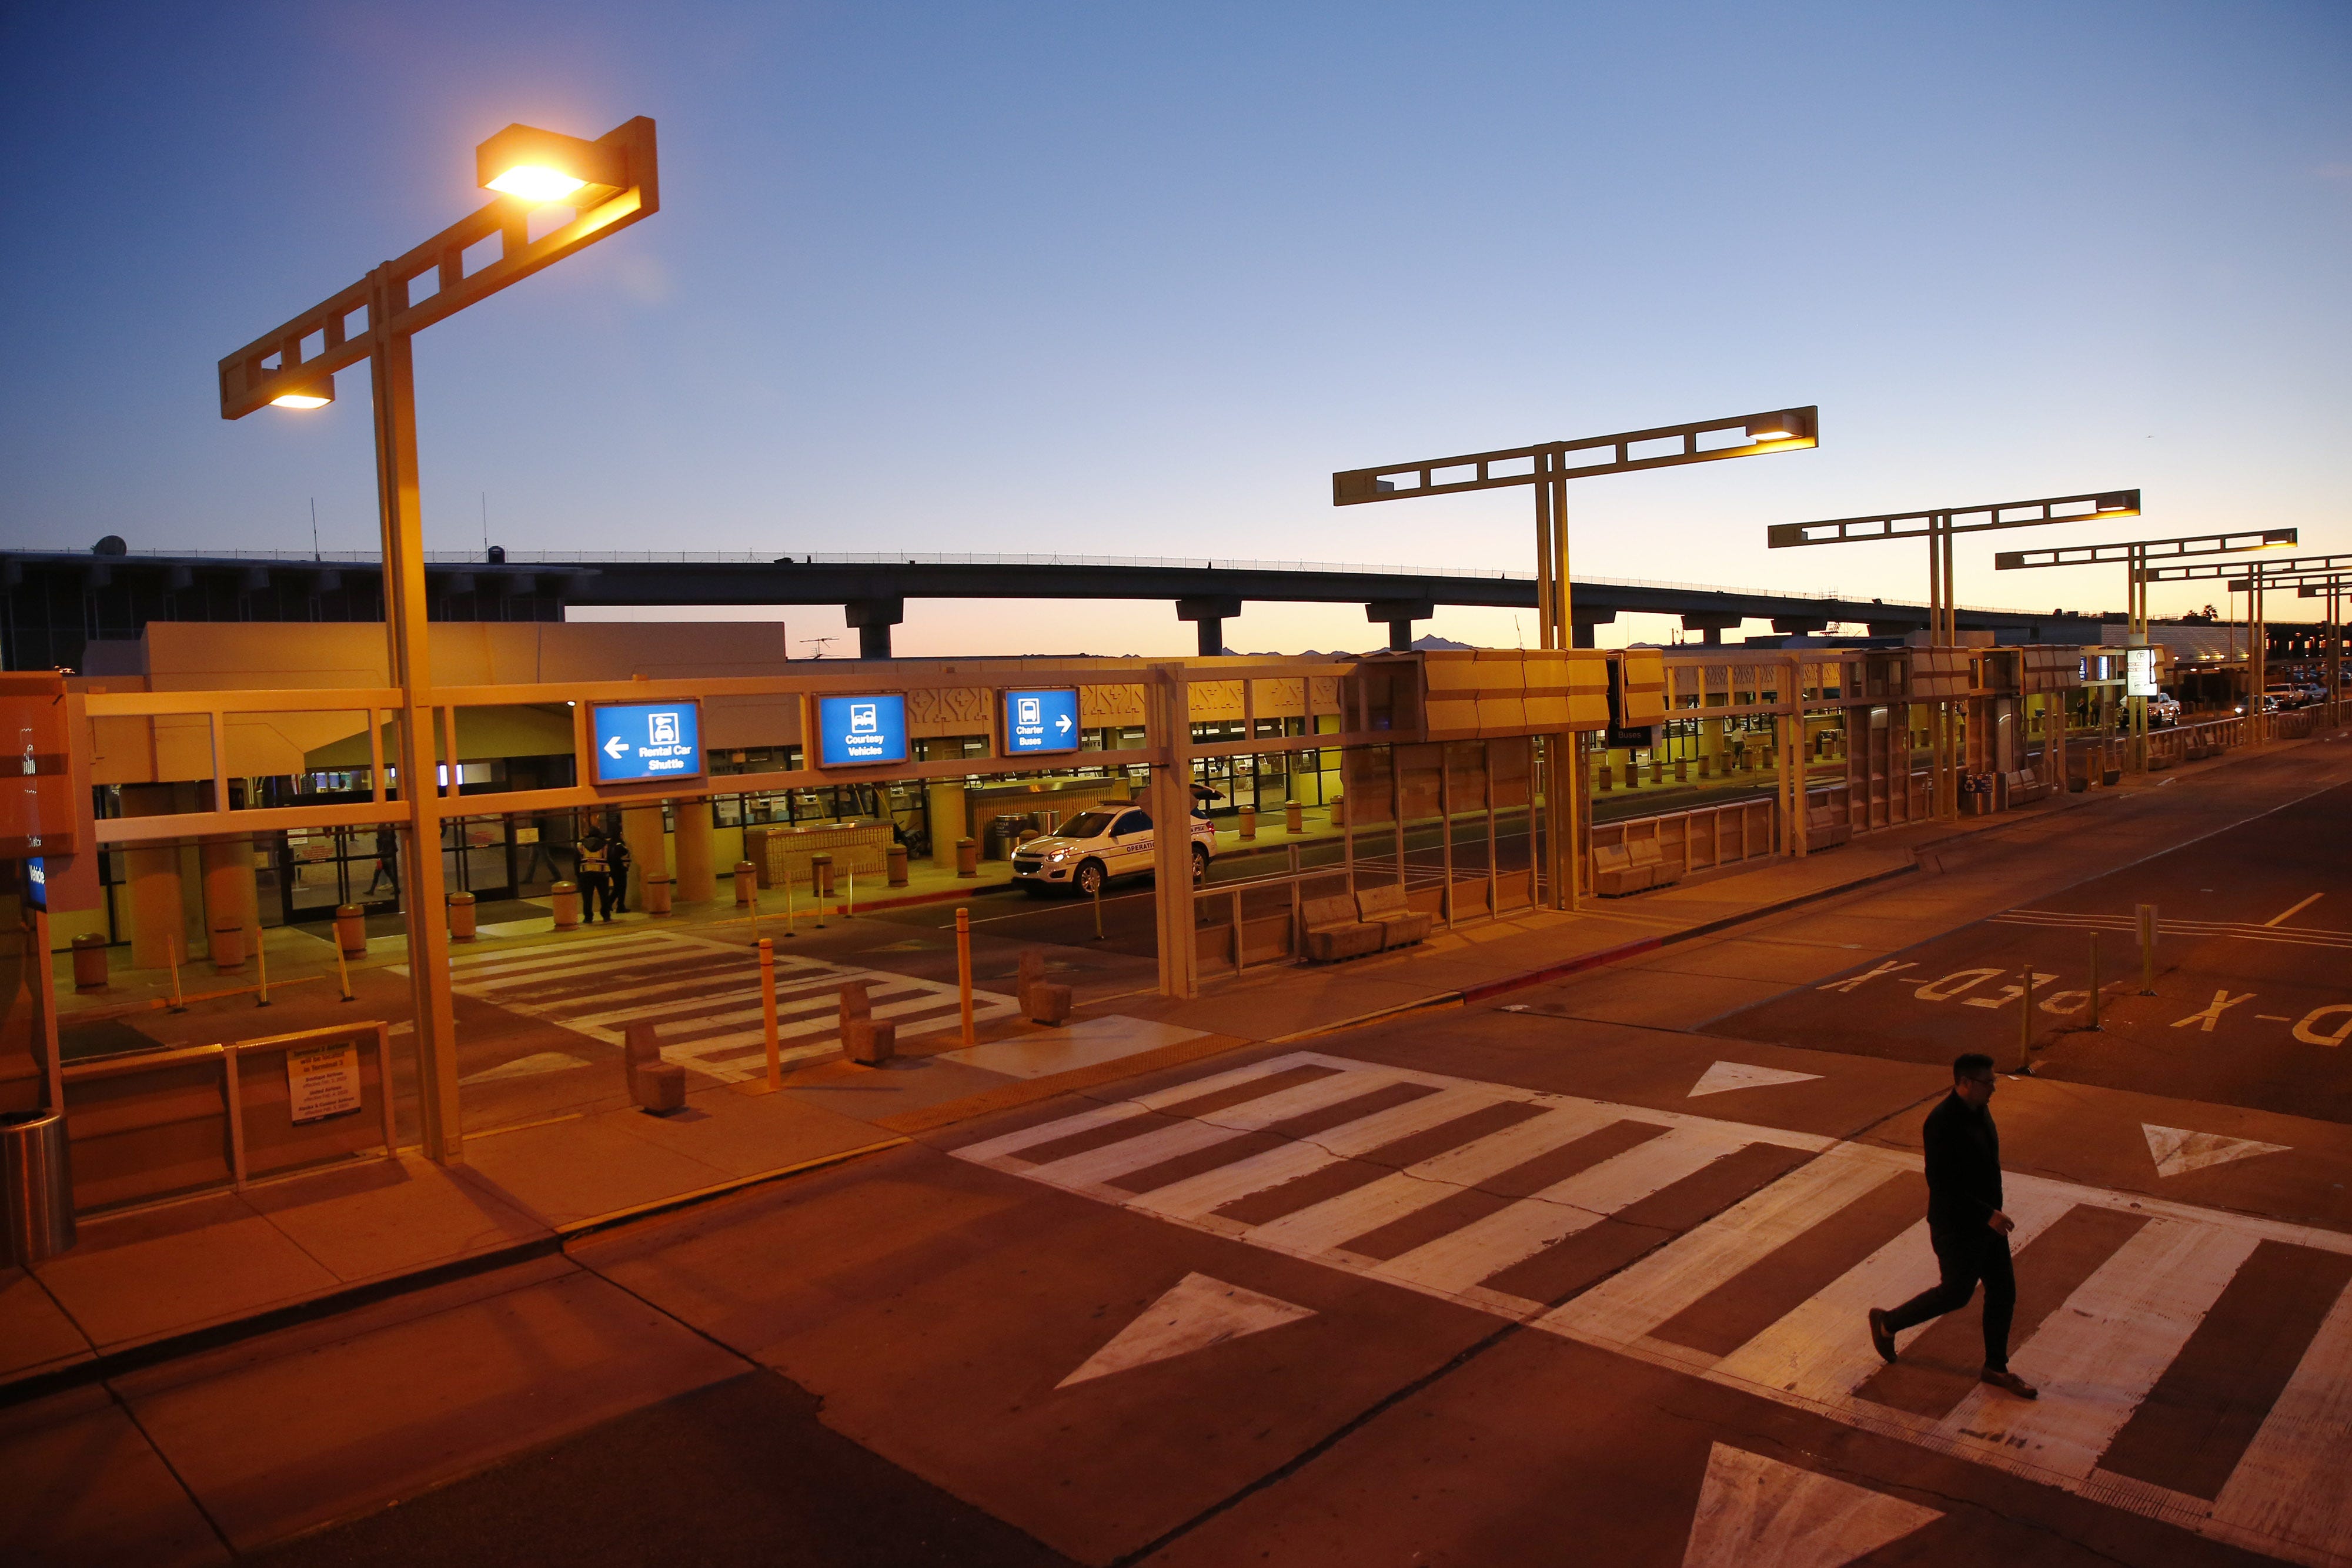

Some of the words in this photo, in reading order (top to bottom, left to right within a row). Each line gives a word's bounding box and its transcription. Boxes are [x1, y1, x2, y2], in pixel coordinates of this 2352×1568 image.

[1015, 726, 1044, 735] Charter
[1618, 731, 1642, 739] Buses
[845, 734, 884, 745] Courtesy
[1019, 737, 1042, 746] Buses
[639, 745, 672, 758] Rental
[673, 745, 691, 755] Car
[848, 745, 883, 757] Vehicles
[649, 758, 684, 771] Shuttle
